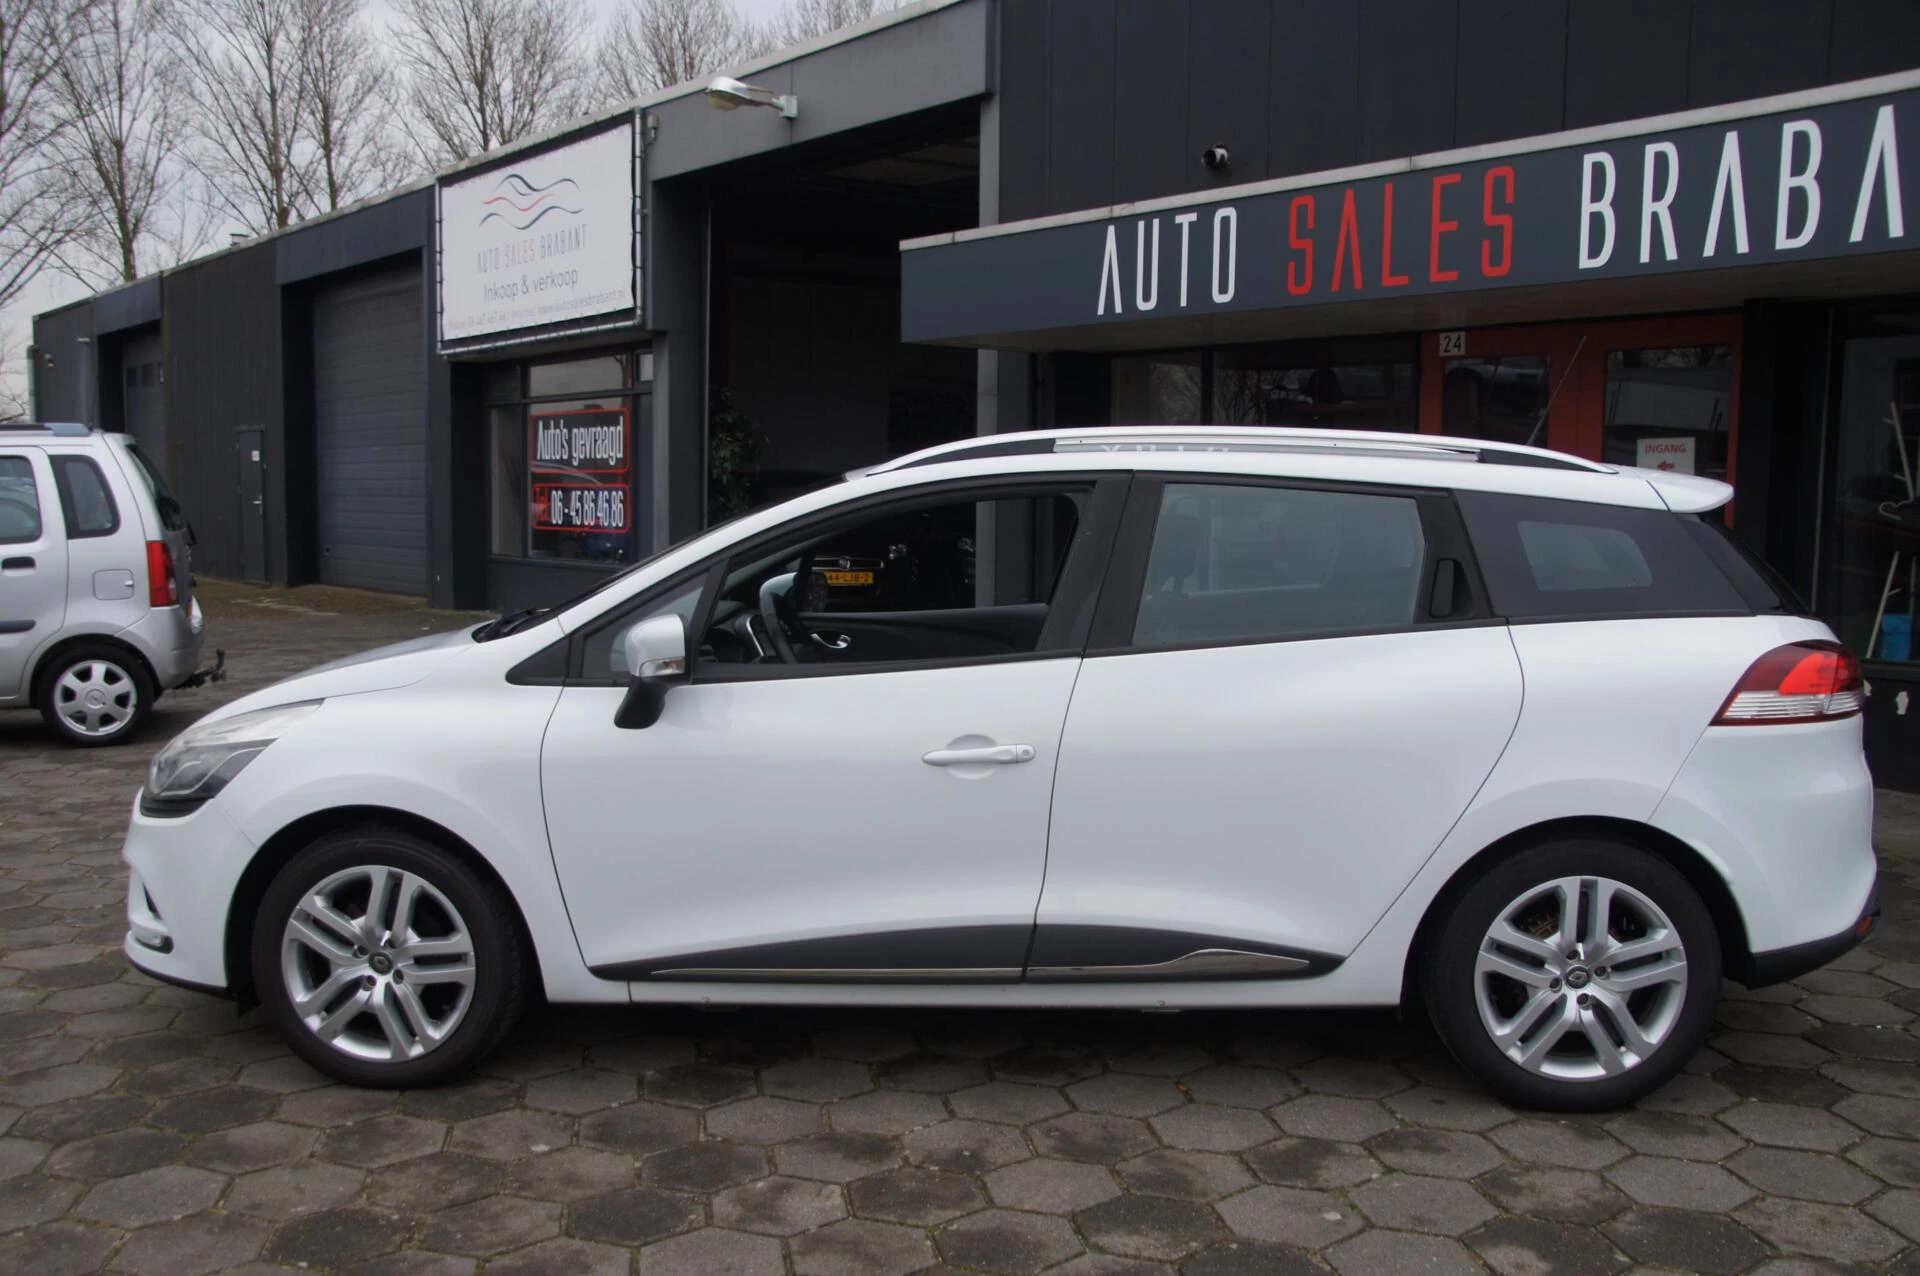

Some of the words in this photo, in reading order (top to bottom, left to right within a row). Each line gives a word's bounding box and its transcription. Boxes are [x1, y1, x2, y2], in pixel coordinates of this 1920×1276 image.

[1097, 206, 1237, 316] AUTO
[1286, 165, 1515, 296] SALES
[1578, 104, 1905, 270] BRABA
[476, 246, 500, 274] AUTO
[504, 238, 535, 268] SALES
[541, 223, 587, 260] BRABANT
[483, 280, 518, 303] Inkoop
[520, 273, 530, 295] &
[532, 268, 578, 293] verkoop
[1442, 333, 1462, 353] 24
[537, 418, 569, 461] Auto's
[571, 415, 624, 466] gevraagd
[1644, 442, 1686, 455] INGANG
